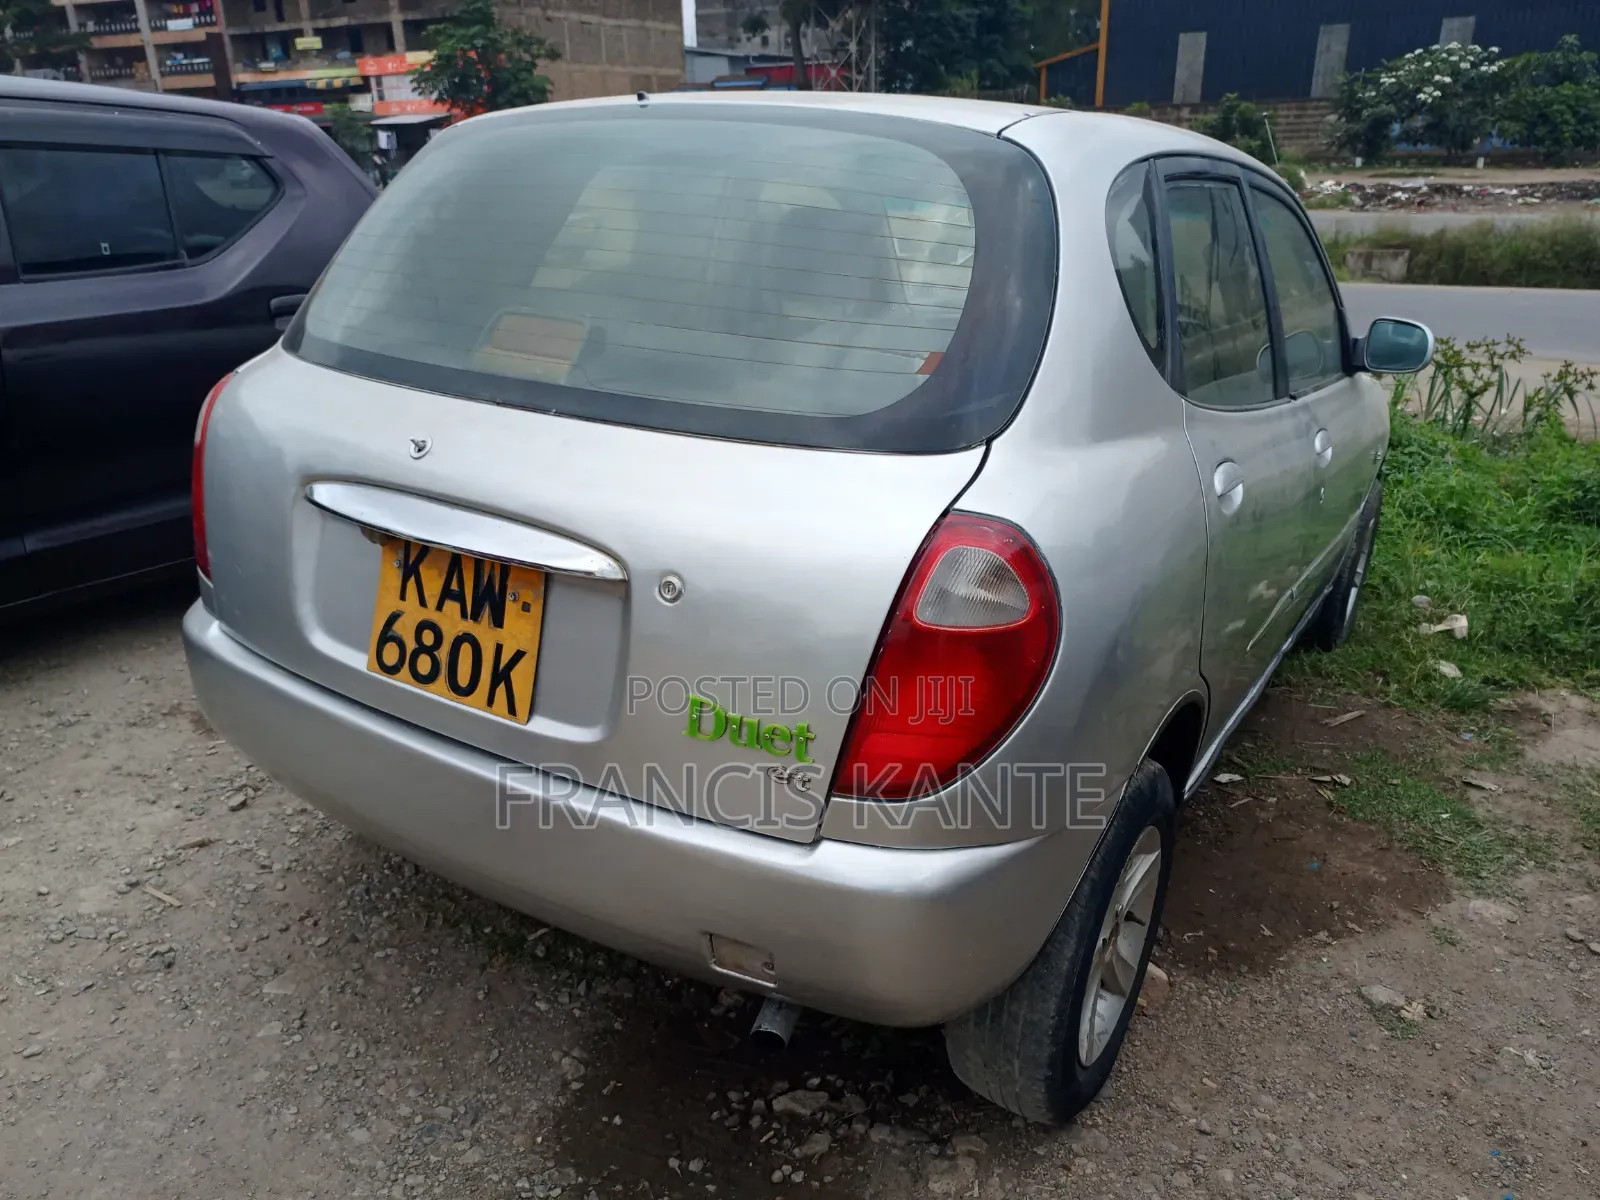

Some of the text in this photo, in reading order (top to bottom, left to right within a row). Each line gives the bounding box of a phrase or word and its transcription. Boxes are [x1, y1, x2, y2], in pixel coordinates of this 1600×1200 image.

[399, 541, 511, 629] KAW
[375, 609, 528, 718] 680K
[681, 692, 816, 764] Duet
